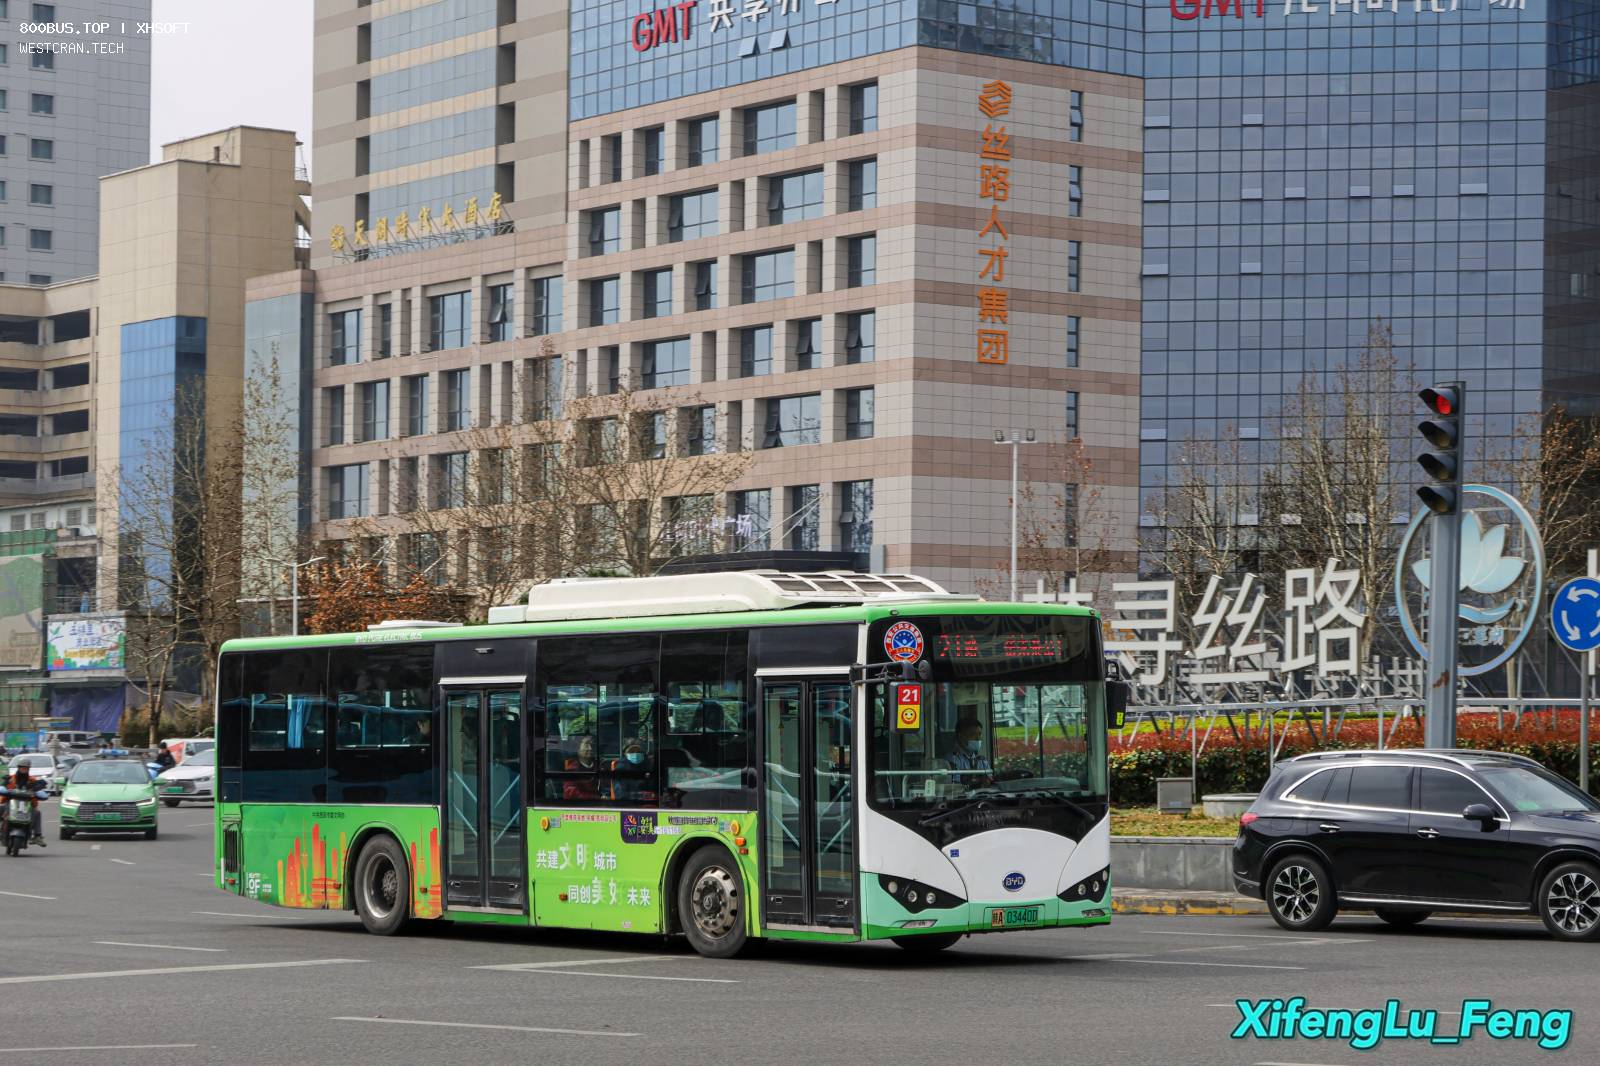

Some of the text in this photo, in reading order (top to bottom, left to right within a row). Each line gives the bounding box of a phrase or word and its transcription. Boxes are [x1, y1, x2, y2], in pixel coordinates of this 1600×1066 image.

[631, 1, 697, 52] GMT
[977, 123, 1011, 365] 丝路人才集团
[1023, 557, 1367, 687] 寻丝路
[902, 689, 918, 702] 21
[1005, 876, 1024, 887] BYD
